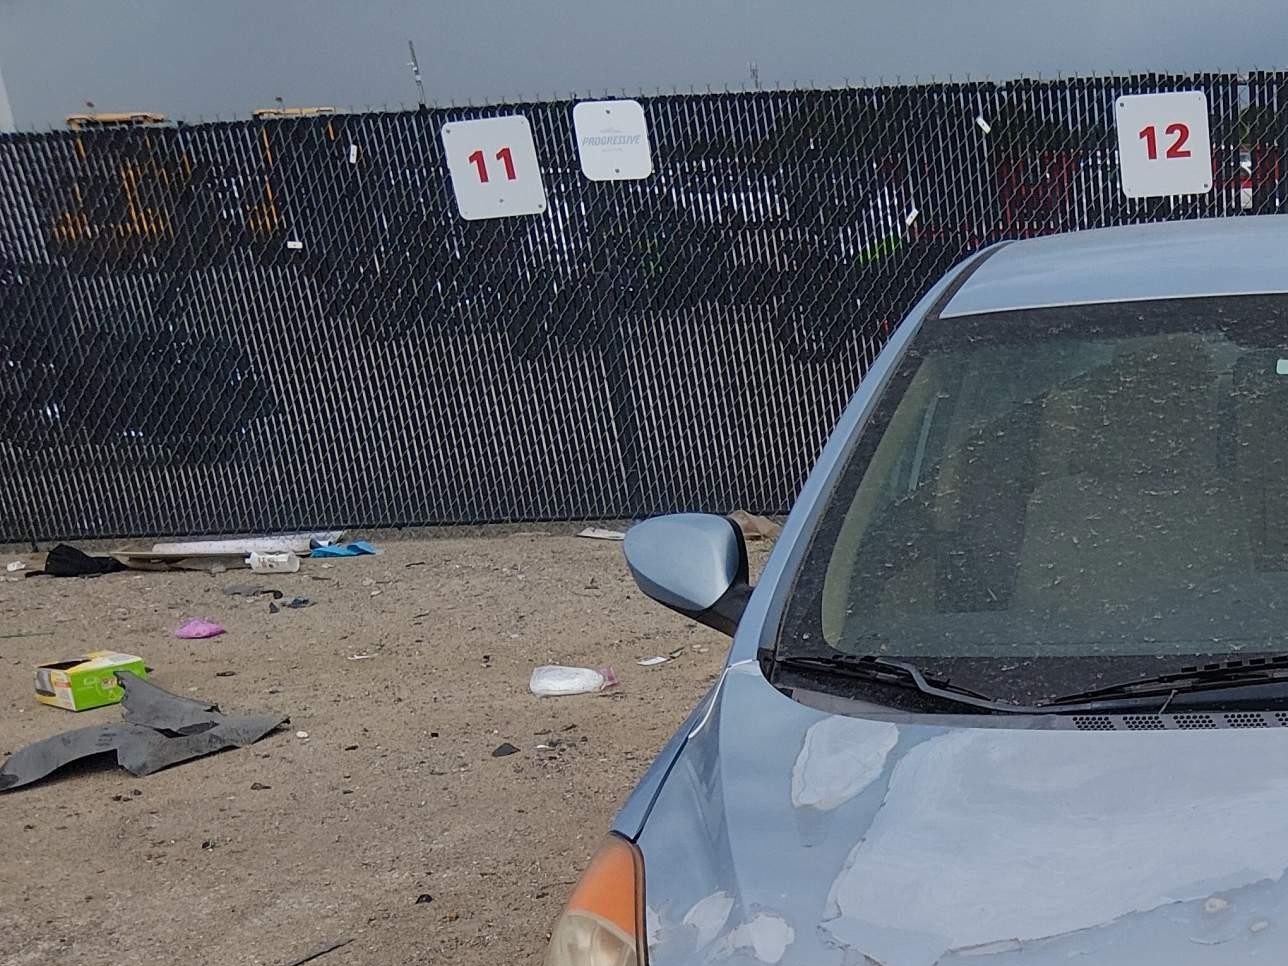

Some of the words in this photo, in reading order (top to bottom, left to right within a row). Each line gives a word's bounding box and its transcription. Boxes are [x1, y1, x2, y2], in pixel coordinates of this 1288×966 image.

[582, 134, 641, 147] PROGRESSIVE
[1139, 123, 1192, 160] 12
[468, 147, 517, 184] 11
